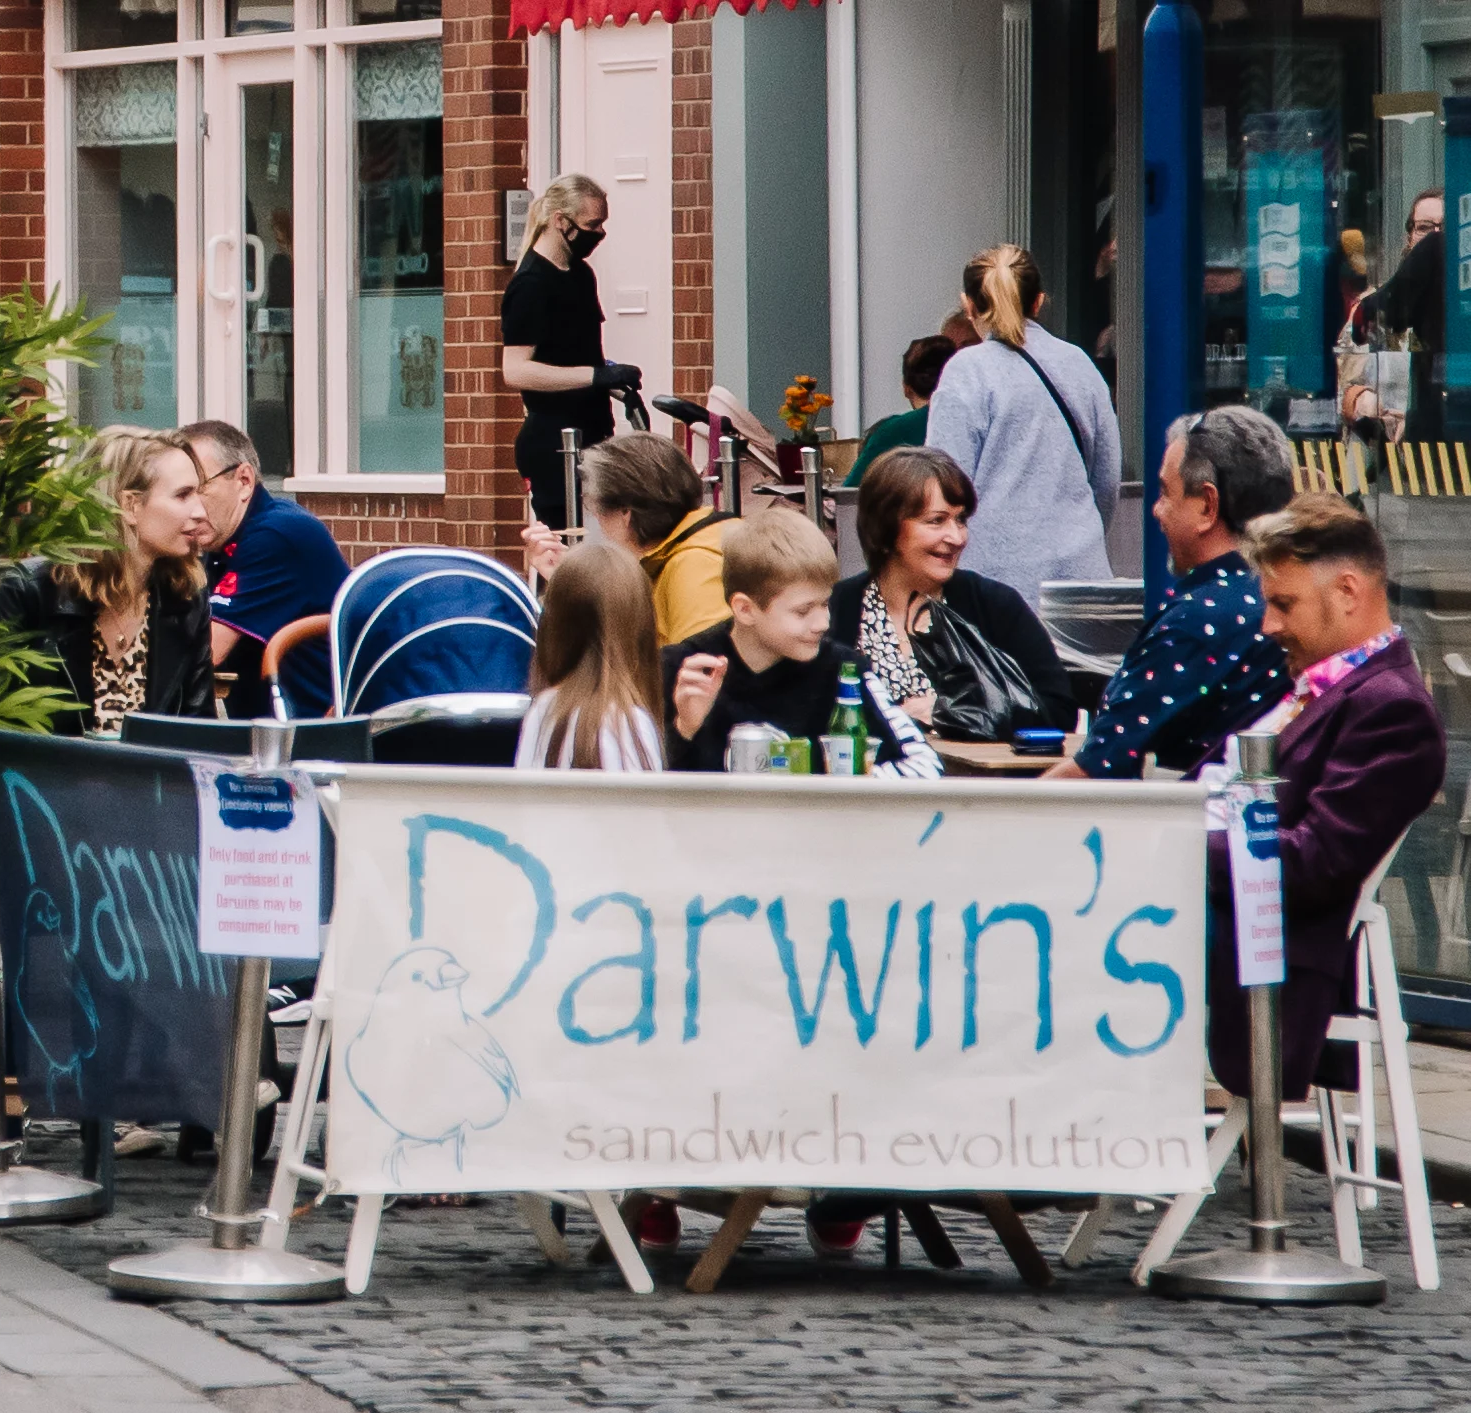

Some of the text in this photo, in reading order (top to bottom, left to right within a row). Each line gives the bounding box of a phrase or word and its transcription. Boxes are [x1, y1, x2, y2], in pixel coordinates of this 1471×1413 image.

[209, 847, 312, 865] Only food and drink
[223, 874, 294, 888] purchased at
[263, 898, 287, 912] may
[289, 897, 303, 911] be
[218, 919, 300, 935] consumed here
[402, 811, 1186, 1059] Darwin's
[563, 1091, 1192, 1170] sandwich evolution
